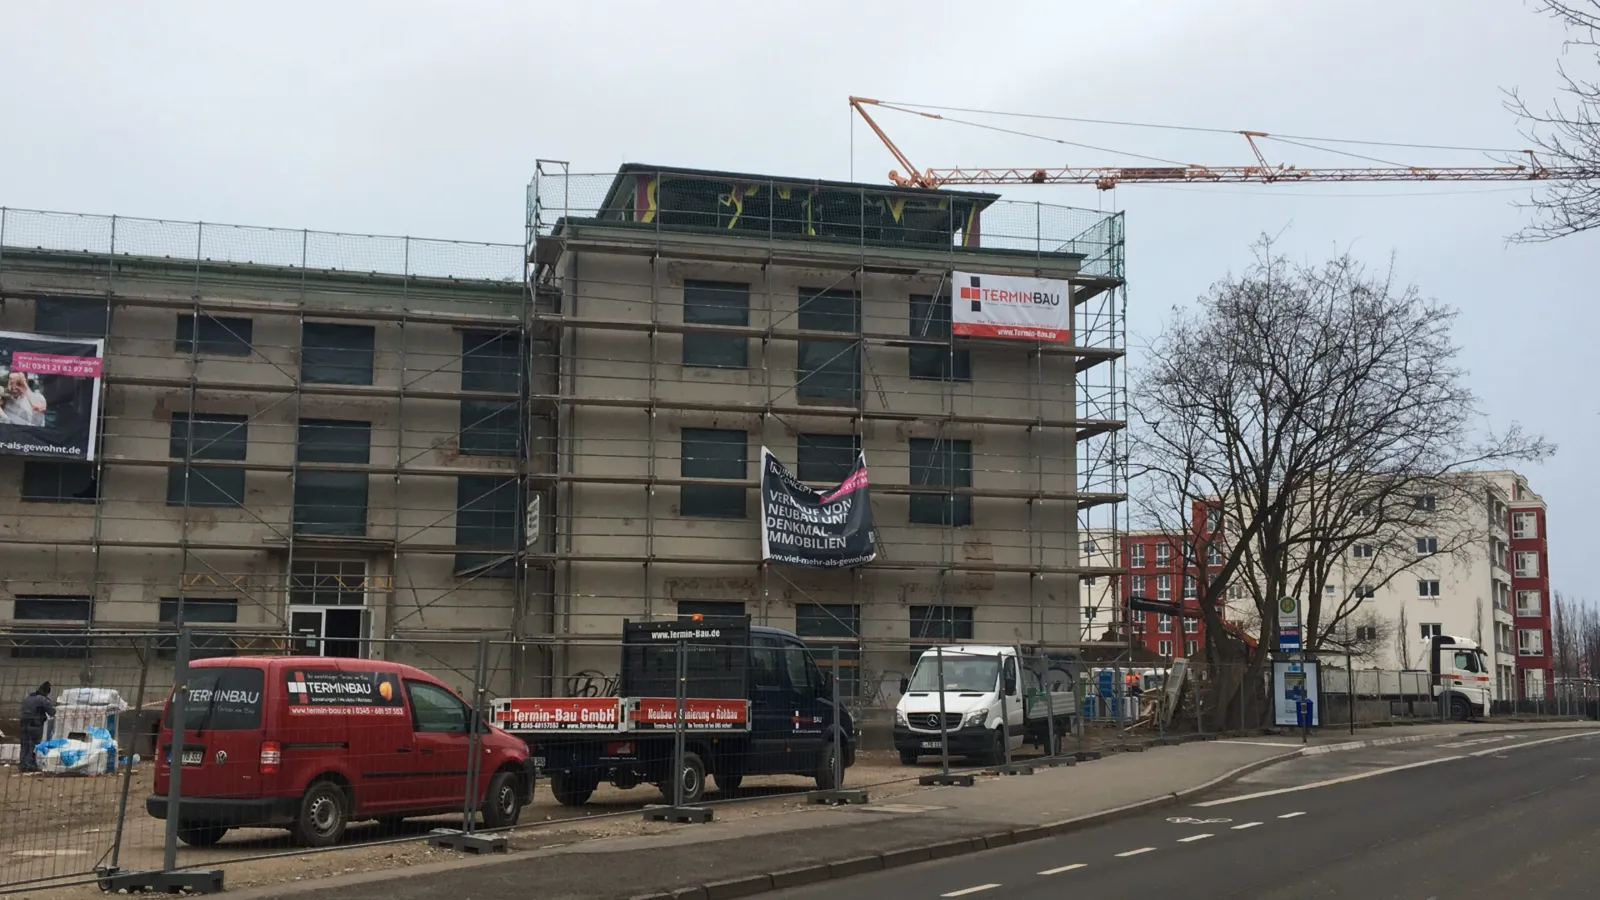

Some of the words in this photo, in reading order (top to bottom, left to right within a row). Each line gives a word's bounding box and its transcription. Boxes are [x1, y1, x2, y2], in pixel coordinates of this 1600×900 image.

[982, 288, 1060, 306] TERMINBAU
[768, 503, 819, 523] NEUBAU
[822, 498, 852, 516] VON
[766, 516, 832, 537] DENKMAL-
[768, 530, 847, 549] MMOBILIEN
[651, 629, 721, 639] www.Termin-Bau.de
[306, 682, 372, 694] TERMINBAU
[512, 708, 577, 722] Termin-Bau
[580, 708, 615, 722] GmbH
